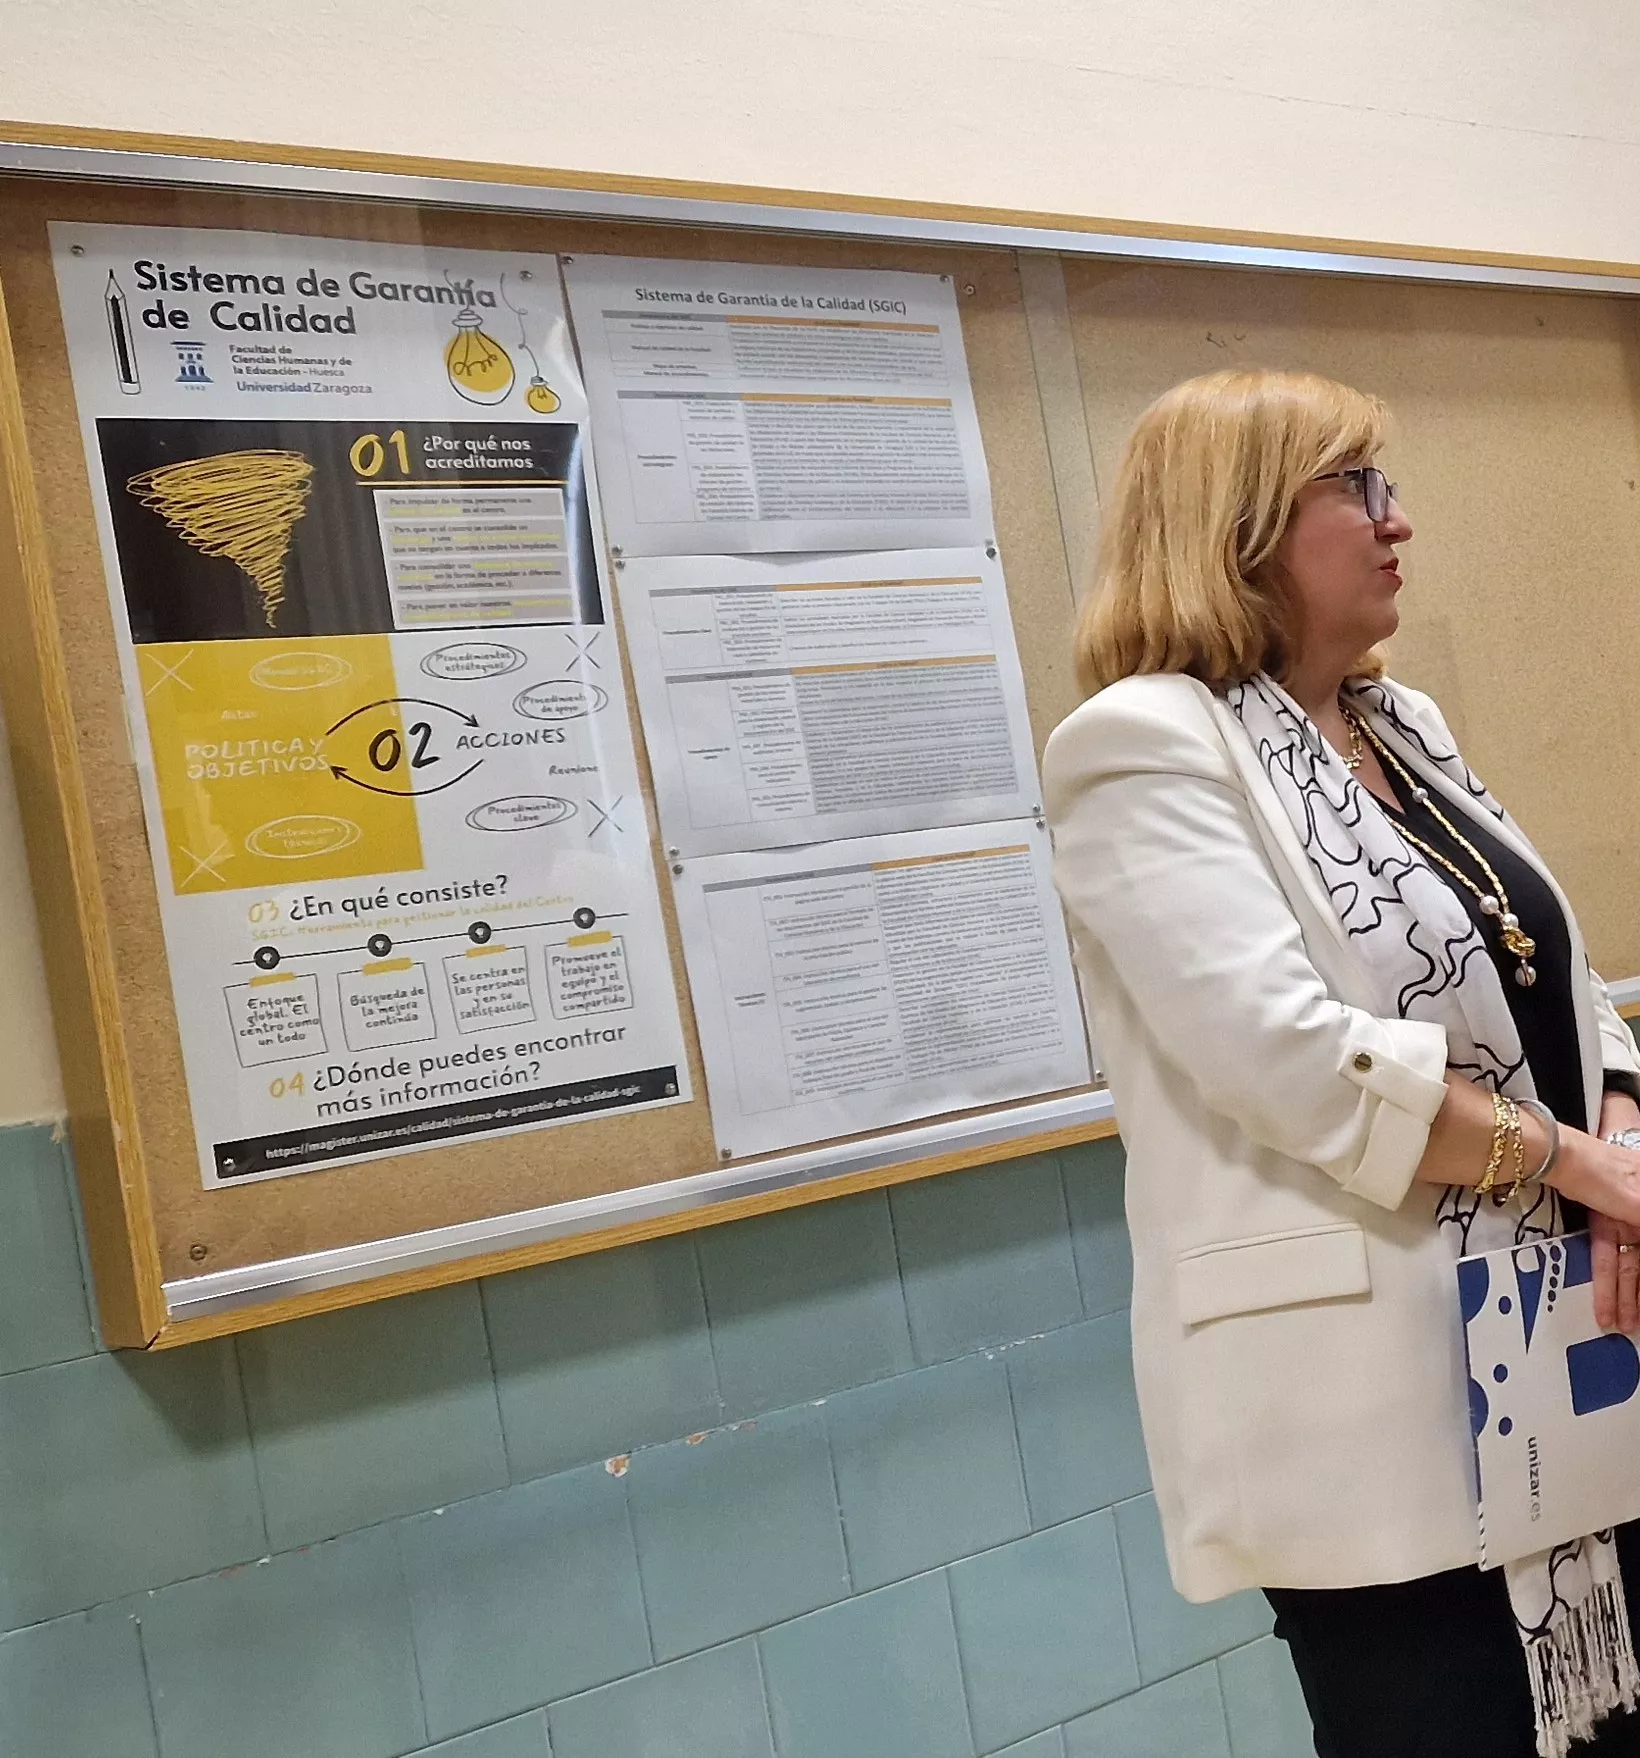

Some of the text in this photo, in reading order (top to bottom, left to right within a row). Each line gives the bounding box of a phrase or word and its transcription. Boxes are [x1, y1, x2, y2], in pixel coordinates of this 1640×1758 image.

[134, 260, 497, 308] Sistema de Garantía
[635, 288, 907, 316] Sistema de Garantía de la Calidad (SGIC)
[142, 299, 357, 335] de Calidad
[229, 345, 276, 354] Facultad
[232, 355, 276, 364] Ciencias
[278, 357, 328, 365] Humanas
[339, 357, 352, 366] de
[234, 366, 243, 374] la
[246, 366, 300, 375] Educación
[309, 368, 345, 377] Huesca
[237, 381, 372, 396] Universidad Zaragoza
[350, 430, 410, 477] 01
[423, 435, 531, 455] ¿Por qué nos
[425, 454, 534, 470] acreditamos
[522, 693, 587, 704] Procedimient
[309, 738, 324, 755] Y
[368, 722, 441, 772] 02
[456, 728, 566, 749] ACCIONES
[187, 755, 329, 780] OBJETIVOS
[549, 765, 599, 776] Reunione
[290, 875, 508, 921] ¿En qué consiste?
[552, 947, 622, 966] Promueve el
[452, 966, 526, 984] Se centra en
[561, 961, 618, 977] trabajo en
[454, 977, 526, 998] las personas
[561, 976, 597, 990] equipo
[609, 971, 620, 981] el
[410, 986, 425, 996] de
[482, 994, 497, 1004] en
[560, 984, 625, 1001] compromiso
[248, 993, 305, 1010] Enfoque
[361, 1001, 418, 1017] la mejora
[562, 994, 626, 1012] compartido
[247, 1003, 309, 1027] global. El
[240, 1018, 320, 1037] centro como
[258, 1031, 306, 1046] un todo
[313, 1026, 627, 1092] ¿Dónde puedes encontrar
[269, 1072, 305, 1098] 04
[317, 1061, 541, 1117] más información?
